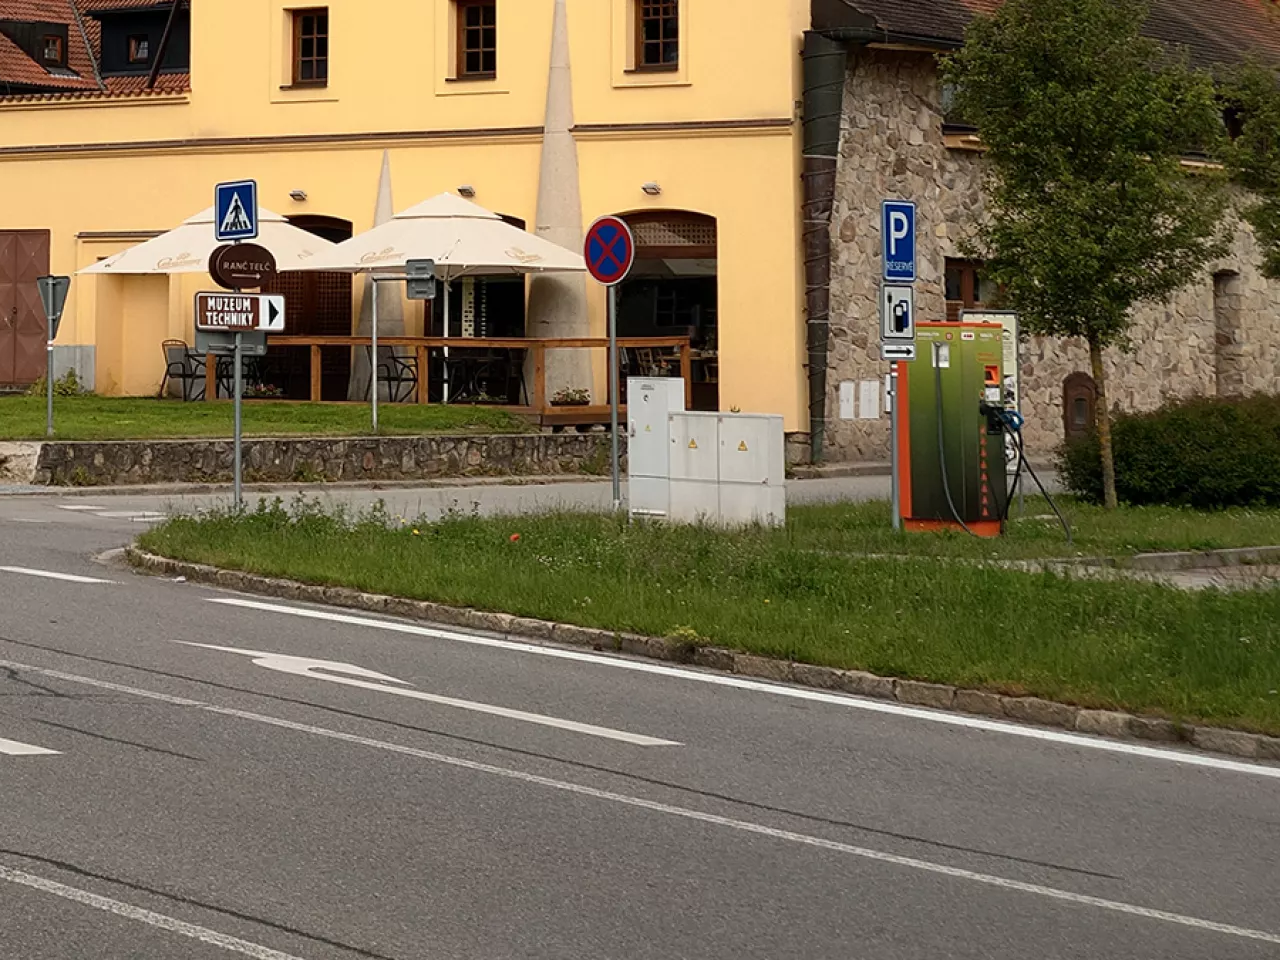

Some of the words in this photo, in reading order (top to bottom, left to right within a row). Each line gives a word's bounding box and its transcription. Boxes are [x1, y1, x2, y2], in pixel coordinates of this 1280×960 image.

[890, 211, 909, 256] P
[223, 260, 249, 271] RANČ
[250, 261, 271, 271] TELČ
[207, 297, 251, 311] MUZEUM
[206, 312, 254, 326] TECHNIKY
